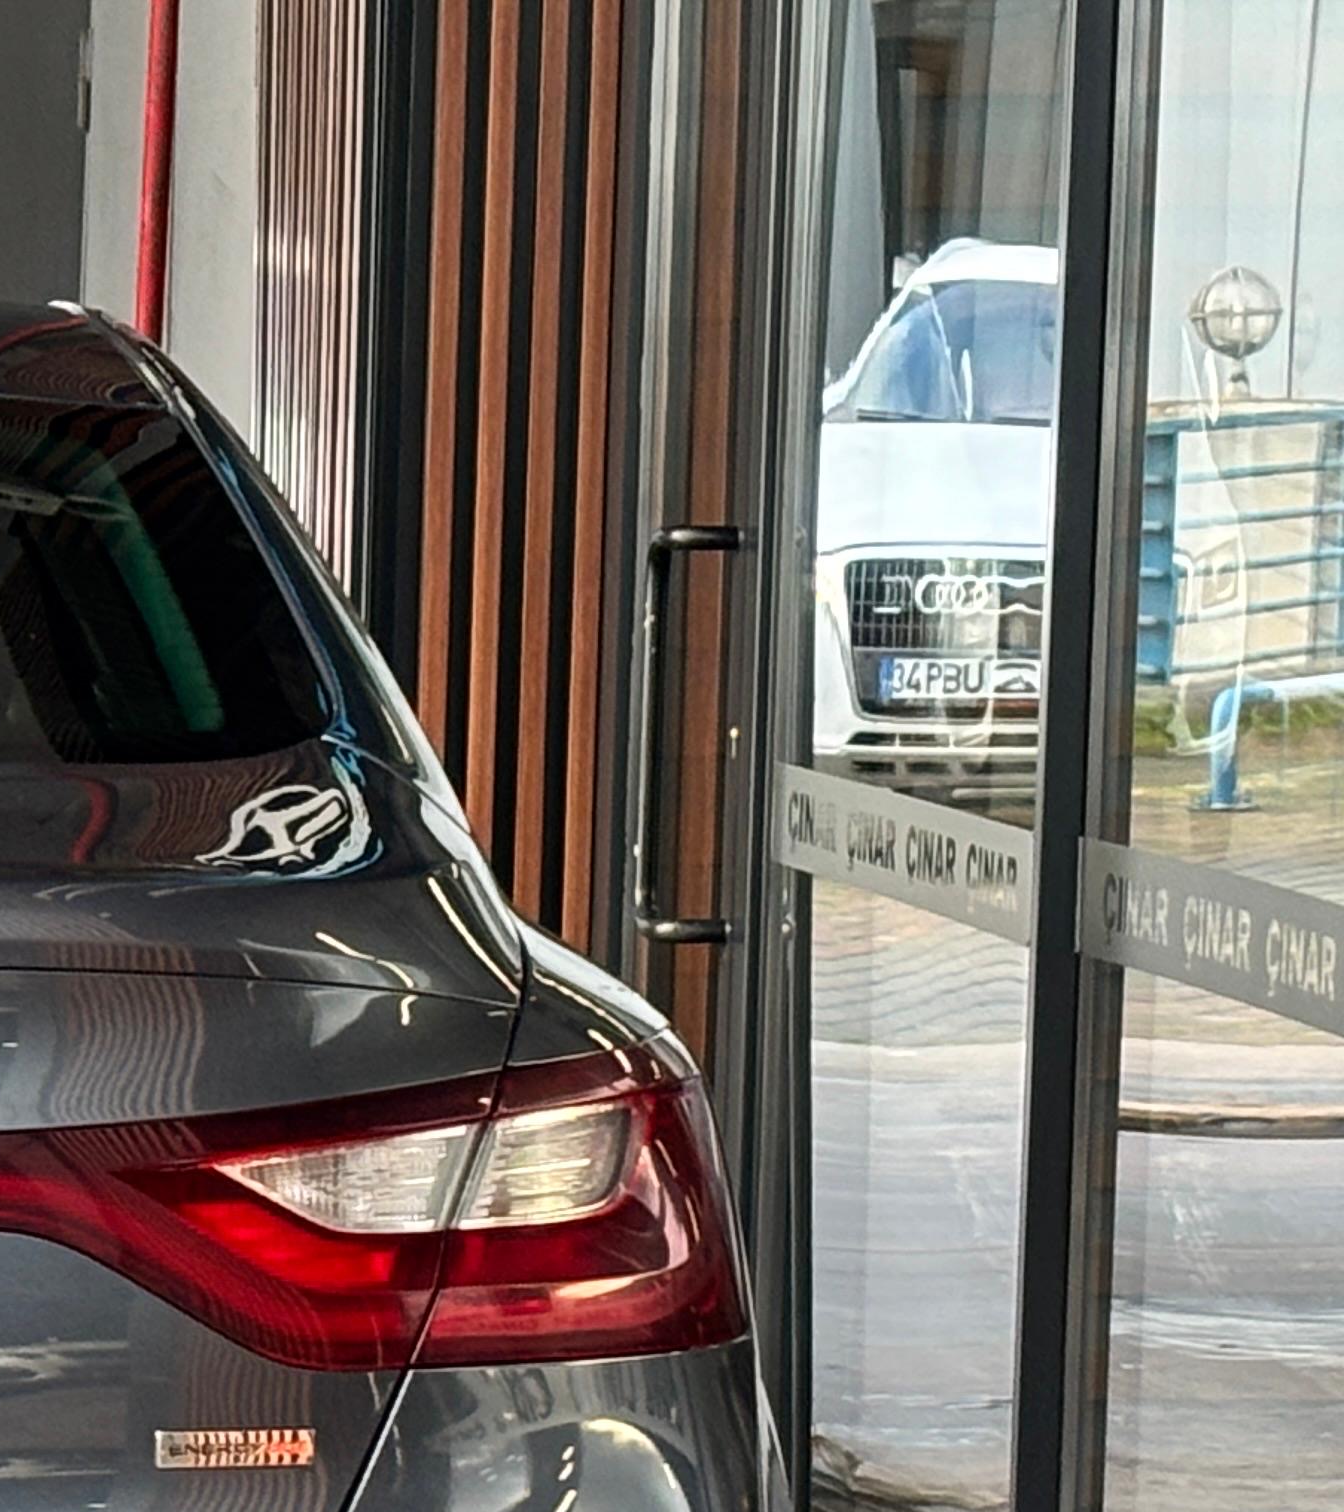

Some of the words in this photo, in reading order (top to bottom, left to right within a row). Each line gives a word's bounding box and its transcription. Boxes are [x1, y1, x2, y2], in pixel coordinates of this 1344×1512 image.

[1103, 872, 1169, 947] ÇINAR
[1183, 895, 1252, 973] ÇINAR
[1266, 918, 1337, 1001] ÇINAR
